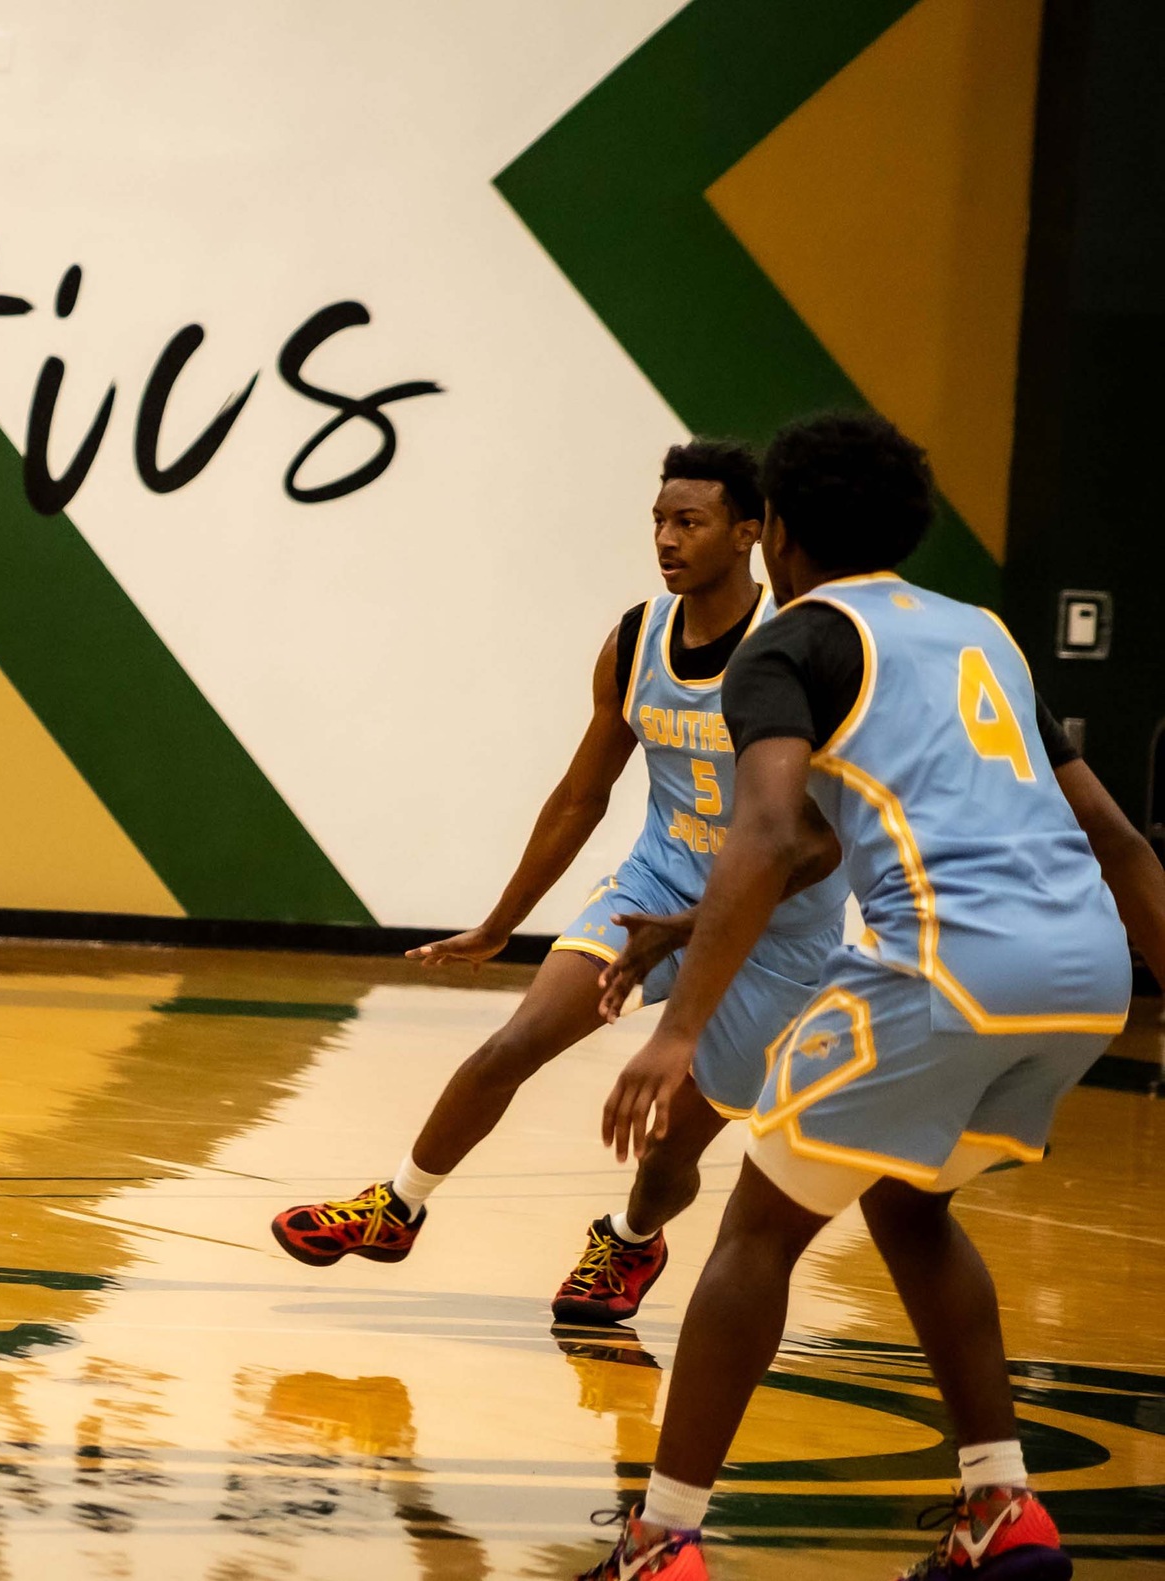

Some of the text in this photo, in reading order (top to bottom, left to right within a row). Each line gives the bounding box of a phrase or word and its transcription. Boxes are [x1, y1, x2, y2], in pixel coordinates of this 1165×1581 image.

[638, 704, 736, 753] SOUTHE
[957, 646, 1037, 783] 4
[690, 758, 723, 816] 5
